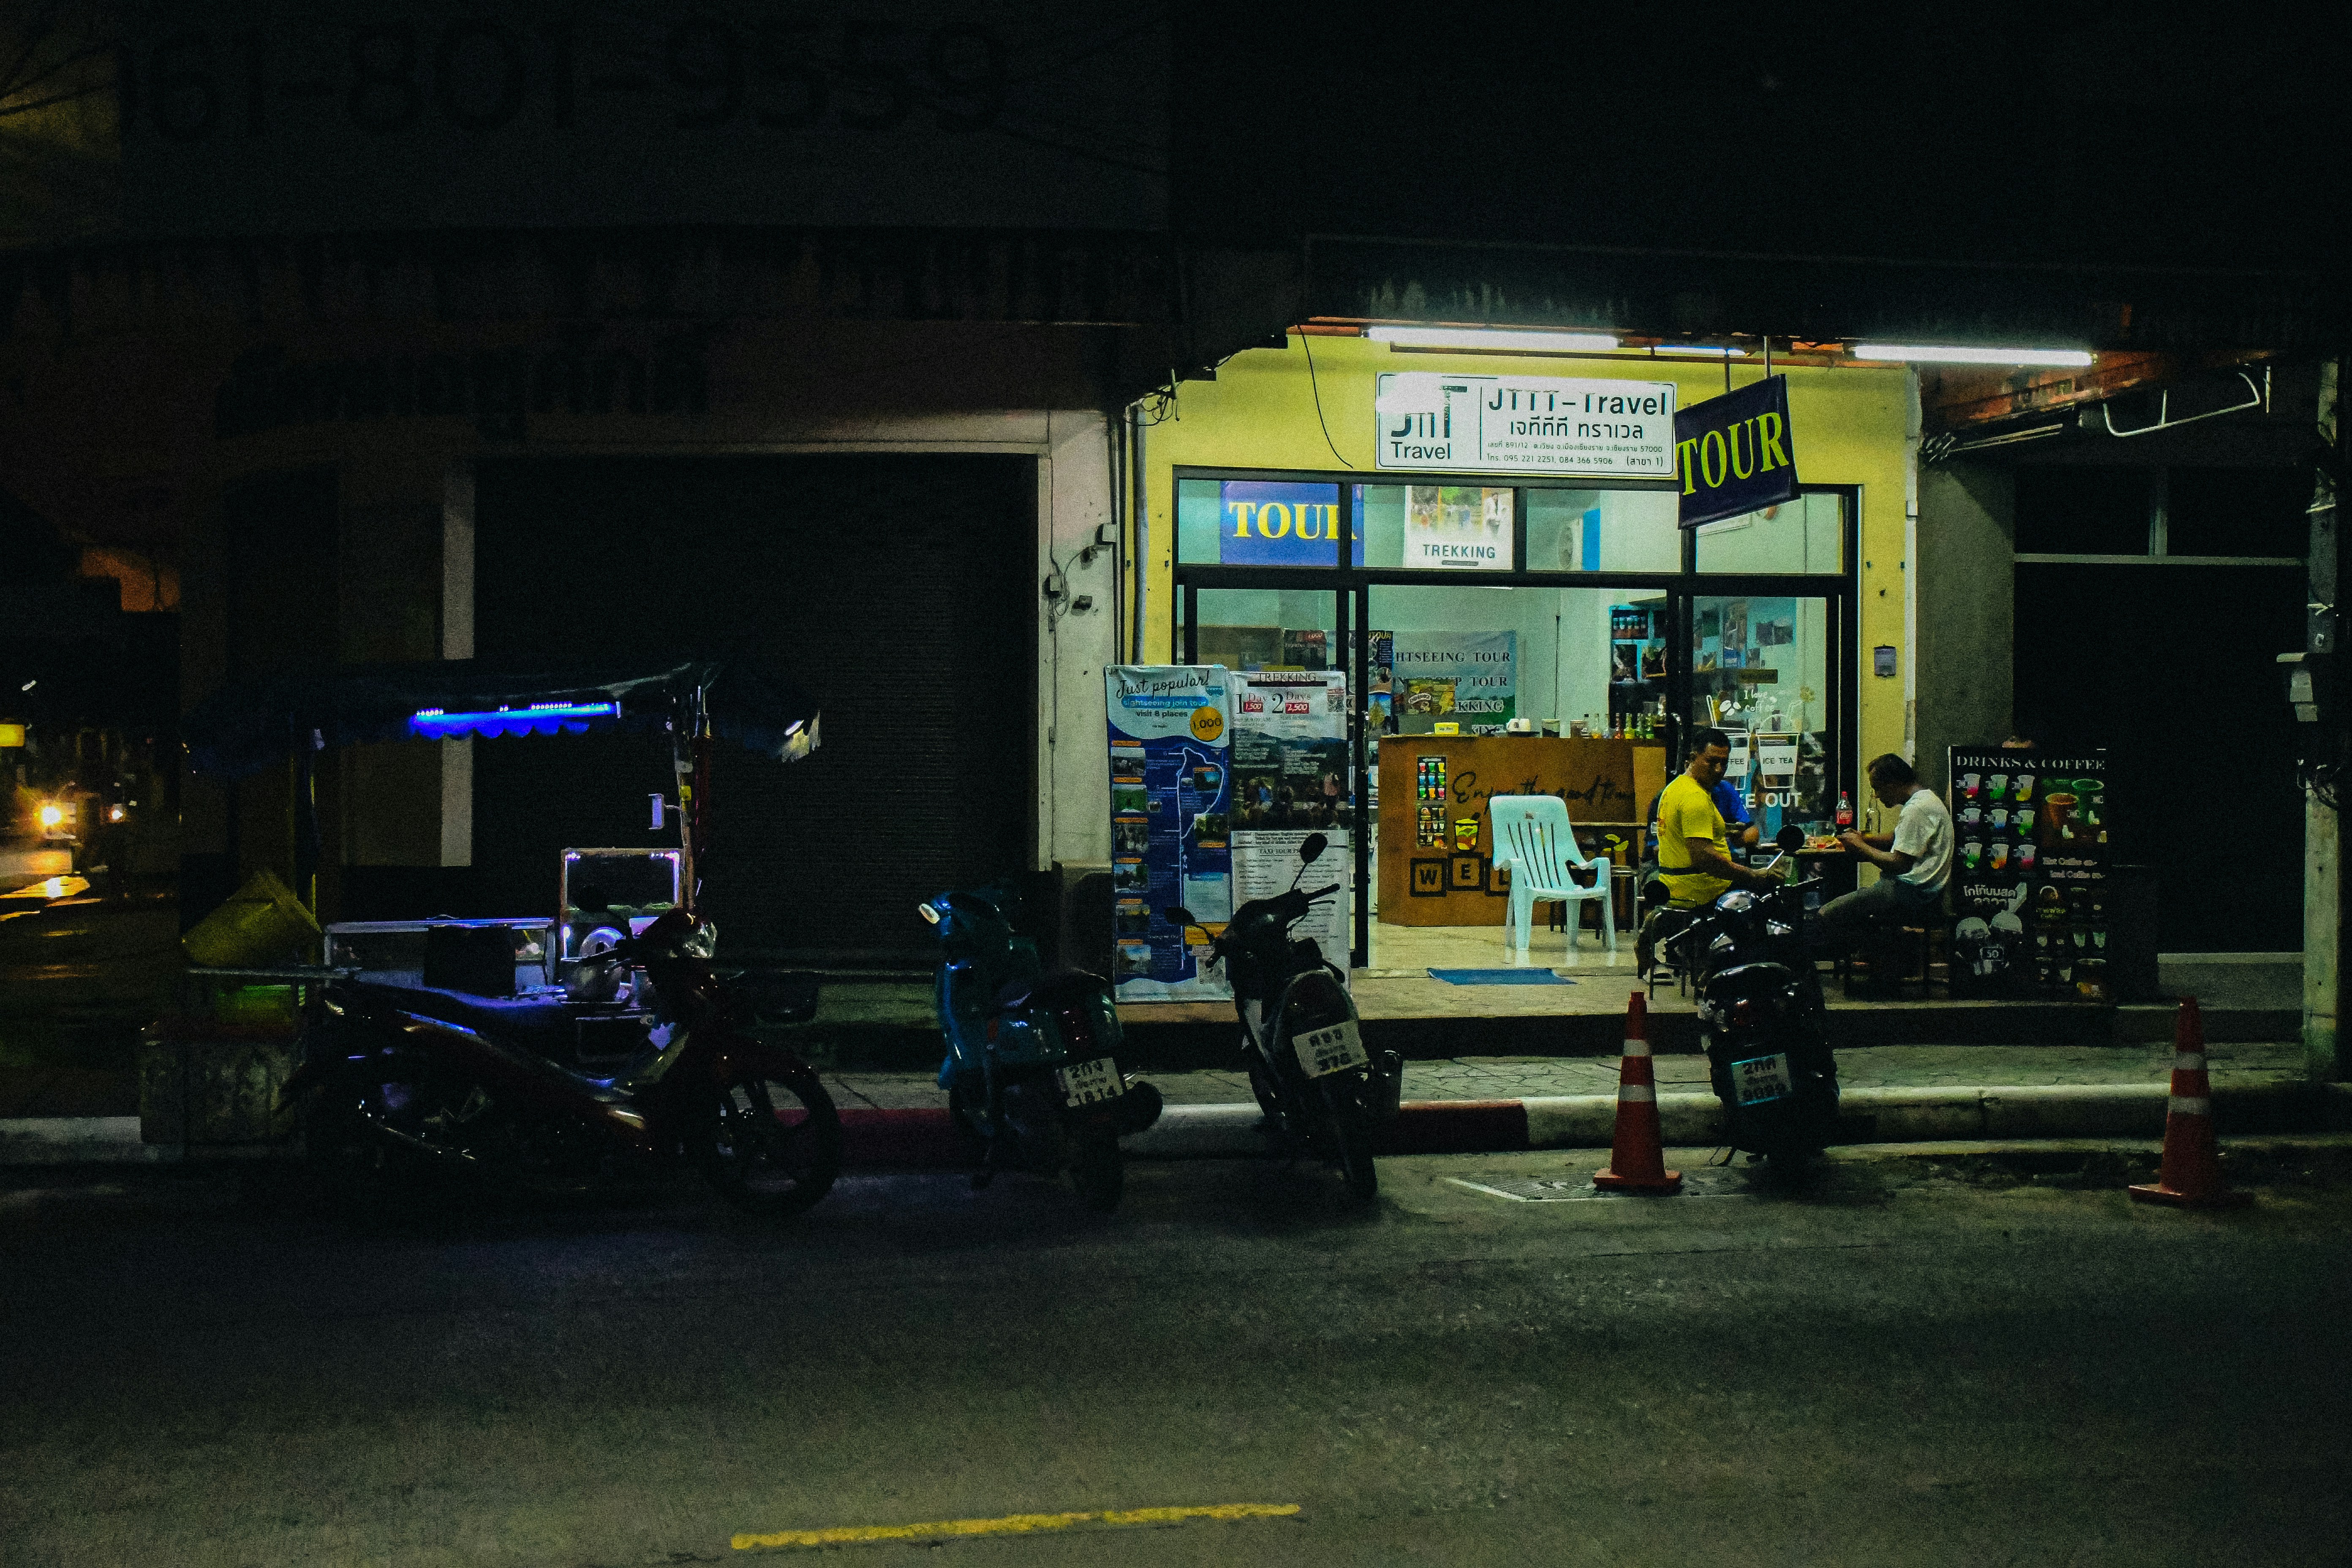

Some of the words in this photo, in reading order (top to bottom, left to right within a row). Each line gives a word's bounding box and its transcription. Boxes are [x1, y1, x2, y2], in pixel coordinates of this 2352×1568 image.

[120, 18, 1010, 142] 61-801-9559
[1511, 416, 1568, 436] เจทีทีที
[1578, 422, 1643, 439] ทราเวล
[1391, 441, 1451, 459] Travel
[1676, 412, 1789, 496] TOUR
[1423, 544, 1496, 559] TREKKING
[1473, 652, 1511, 662] TOUR
[1116, 678, 1149, 699] Just
[1152, 670, 1210, 698] popular!
[1258, 672, 1317, 681] TREKKING
[1470, 677, 1507, 687] TOUR
[1271, 693, 1284, 714] 2
[1956, 756, 2021, 768] DRINKS
[2041, 759, 2105, 770] COFFEE
[1765, 792, 1802, 808] OUT
